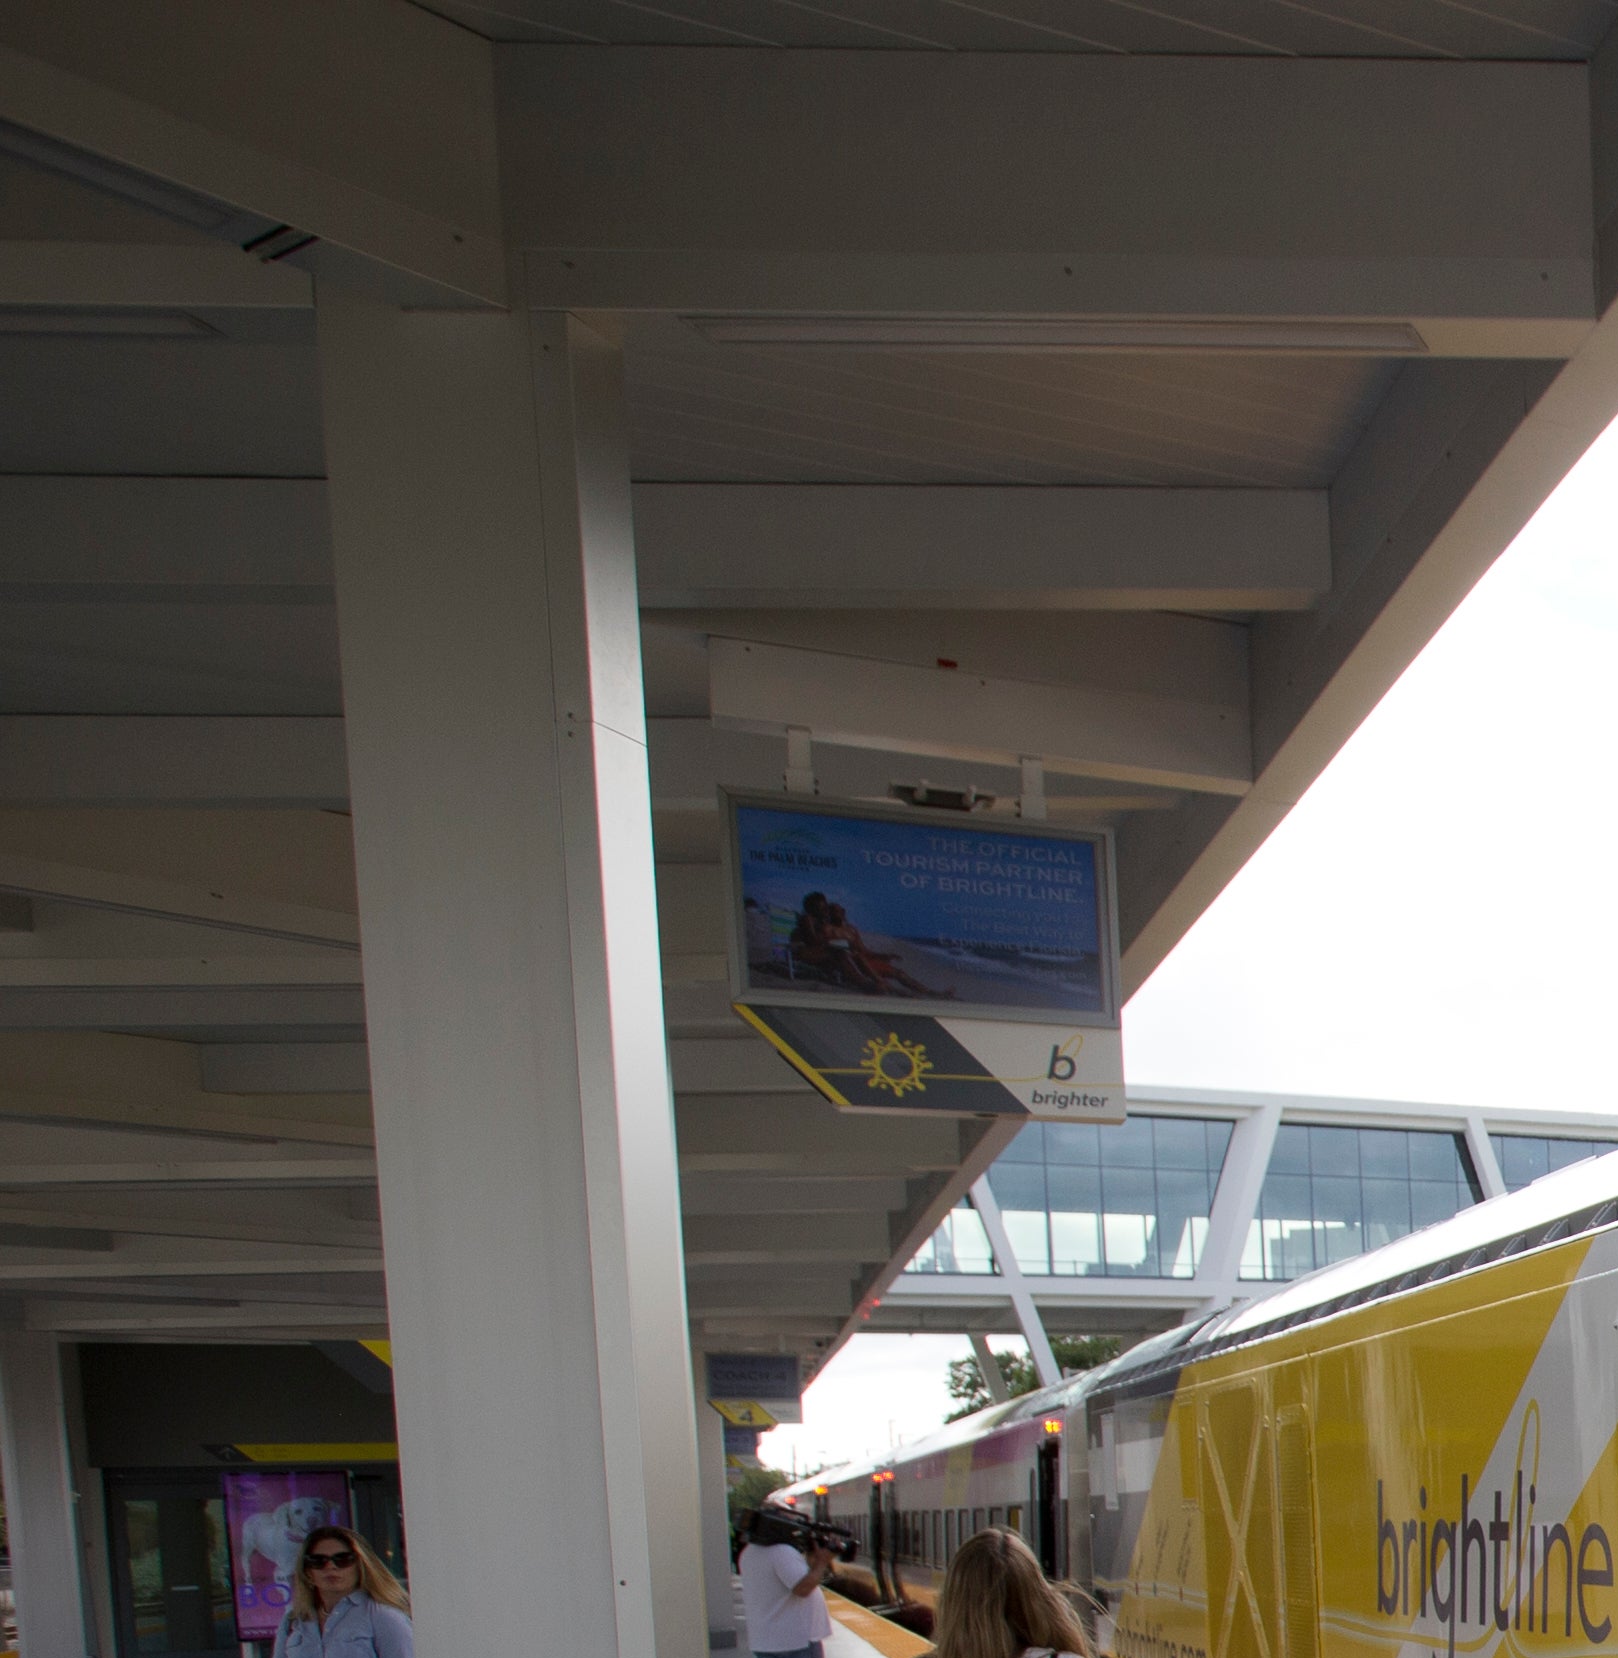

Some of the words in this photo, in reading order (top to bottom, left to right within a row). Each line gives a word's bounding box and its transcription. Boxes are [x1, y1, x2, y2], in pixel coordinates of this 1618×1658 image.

[929, 836, 973, 855] THE
[979, 841, 1081, 866] OFFICIAL
[862, 850, 969, 874] TOURISM
[975, 861, 1083, 885] PARTNER
[900, 871, 932, 889] OF
[1031, 1090, 1109, 1109] brighter
[739, 1408, 753, 1422] 4
